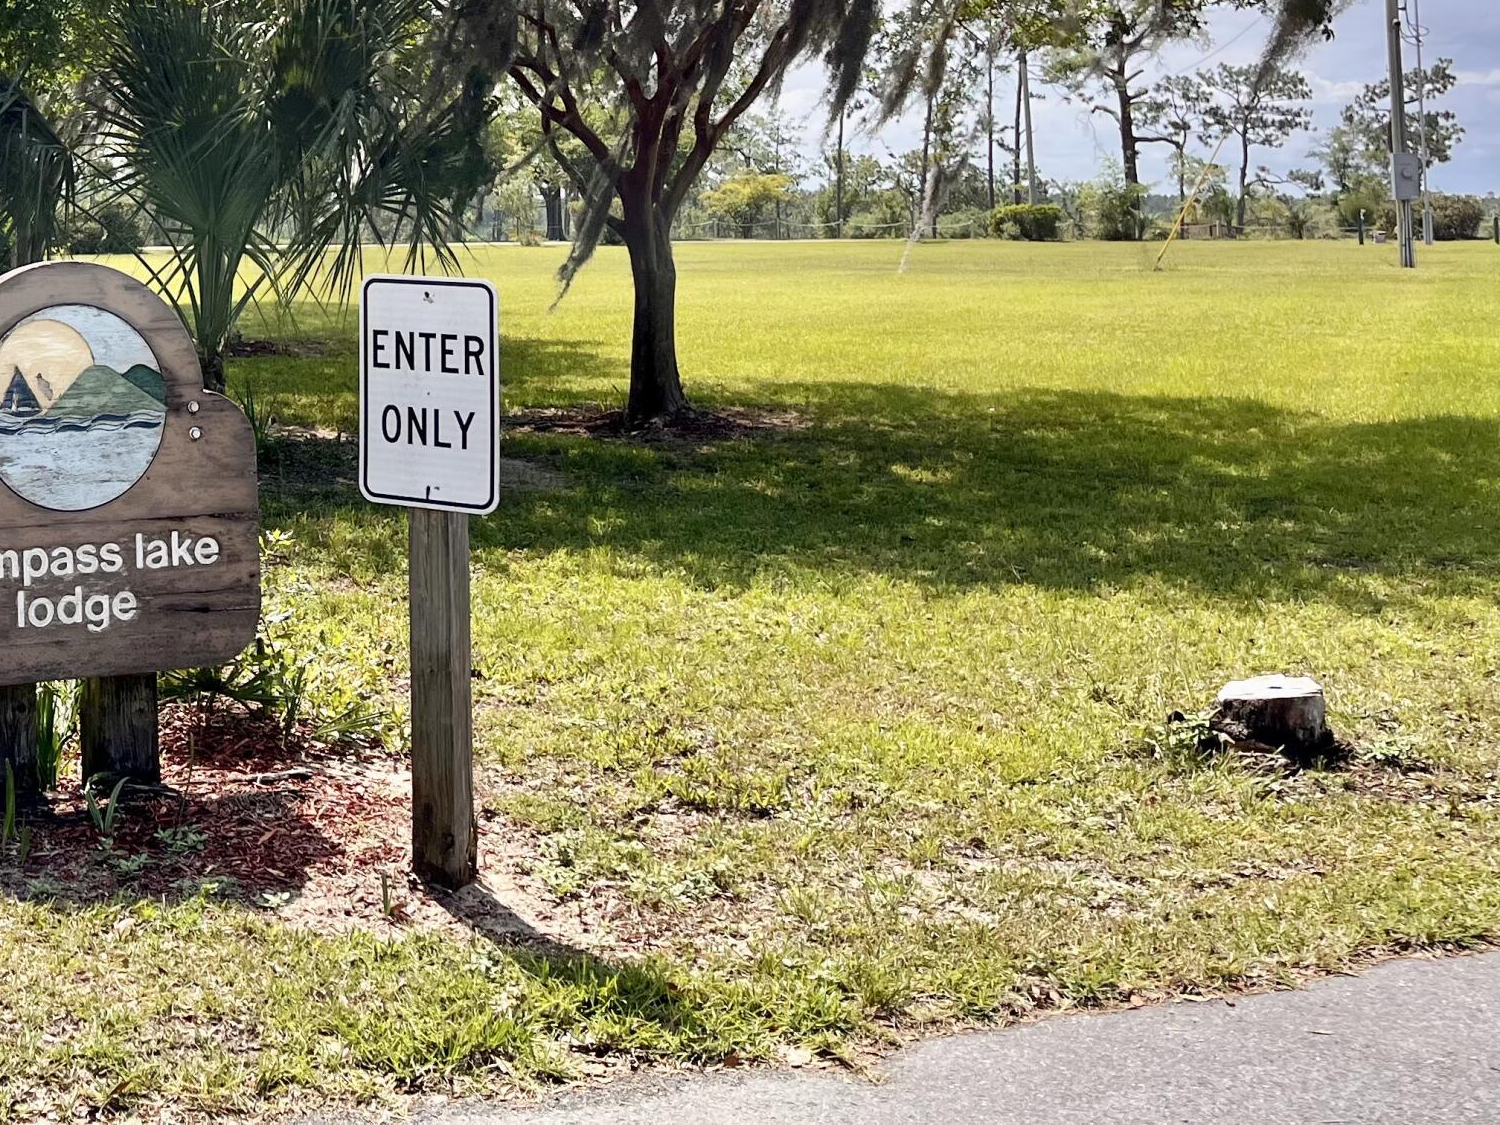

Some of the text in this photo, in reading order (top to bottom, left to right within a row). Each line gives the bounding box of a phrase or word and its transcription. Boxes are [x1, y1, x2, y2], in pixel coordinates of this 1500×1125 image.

[372, 329, 485, 376] ENTER
[381, 404, 476, 450] ONLY
[135, 531, 220, 570] lake
[17, 586, 138, 632] lodge
